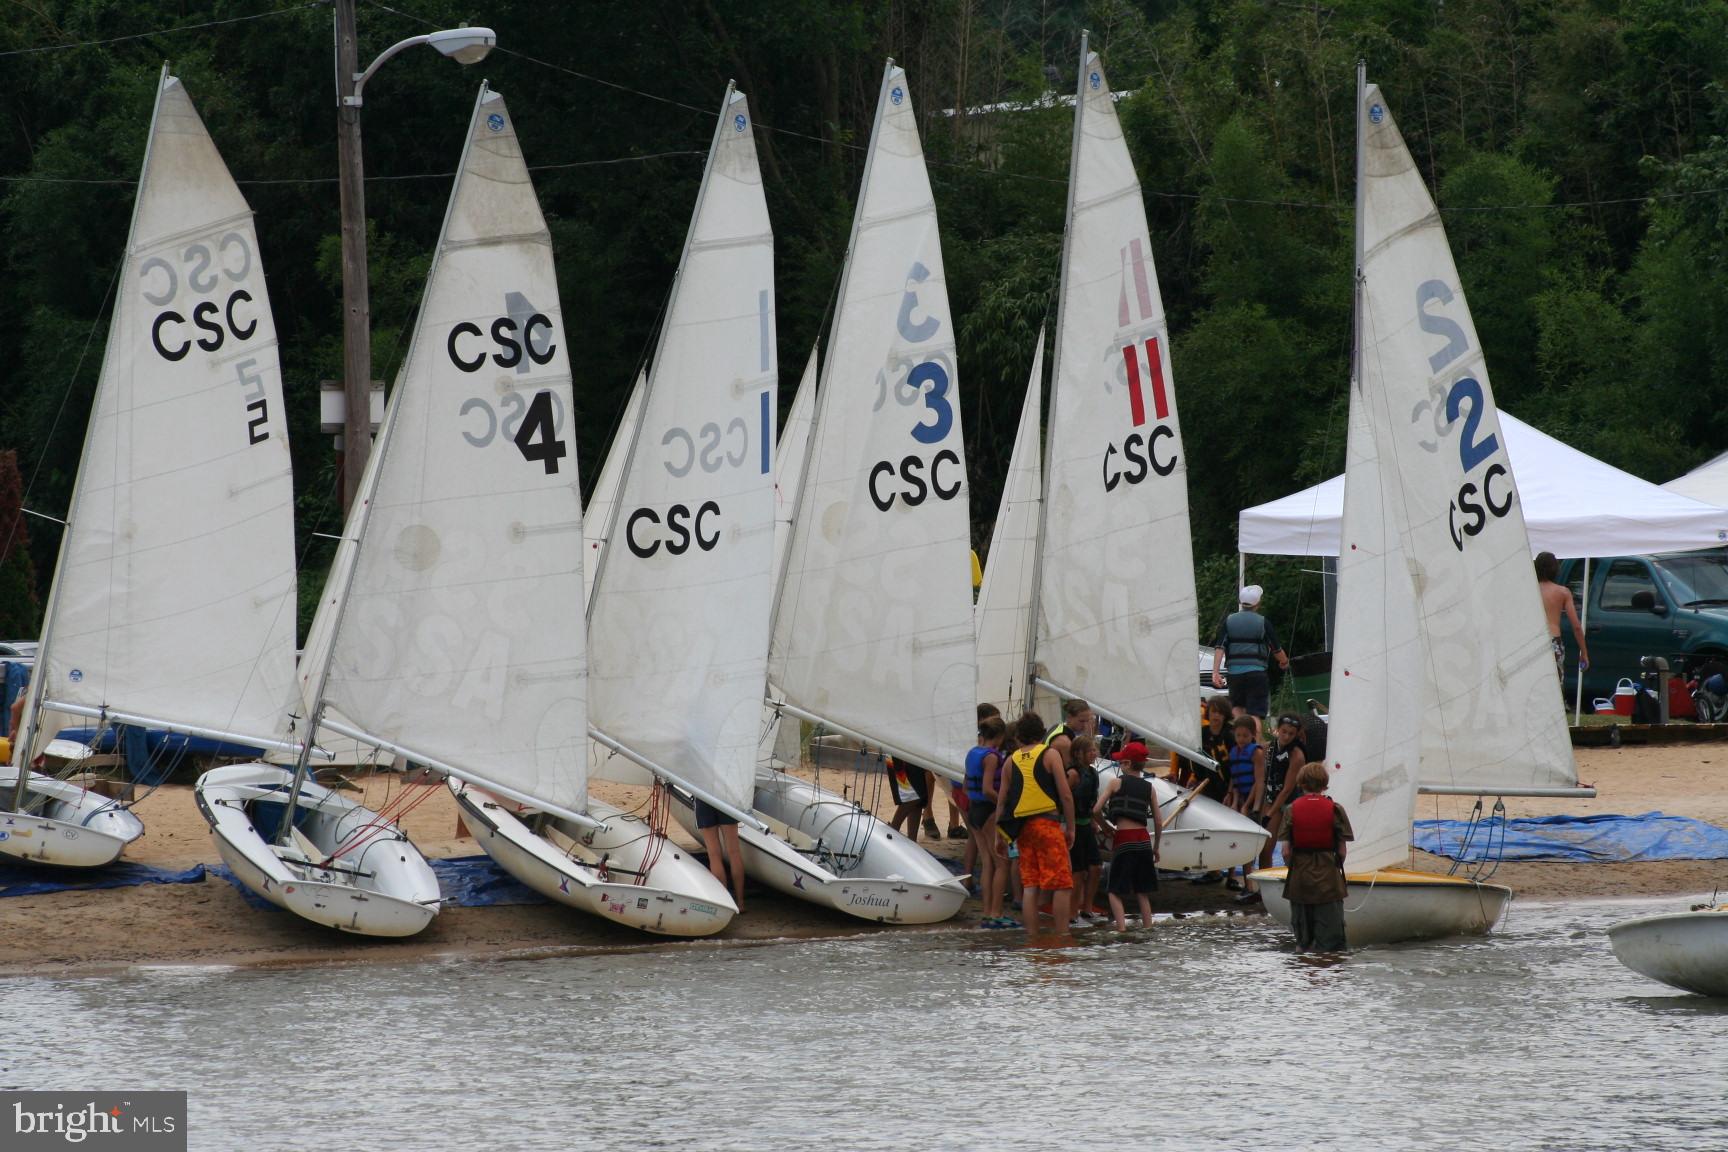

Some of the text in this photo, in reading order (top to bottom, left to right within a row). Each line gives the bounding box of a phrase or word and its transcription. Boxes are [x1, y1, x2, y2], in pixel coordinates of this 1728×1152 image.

[152, 289, 257, 362] CSC
[447, 313, 557, 373] CSC
[907, 361, 953, 444] 3
[1123, 336, 1169, 427] 11
[514, 391, 567, 475] 4
[1103, 424, 1178, 493] CSC
[1446, 377, 1499, 474] 2
[868, 449, 962, 513] CSC
[626, 500, 721, 559] CSC
[847, 893, 890, 907] Joshua
